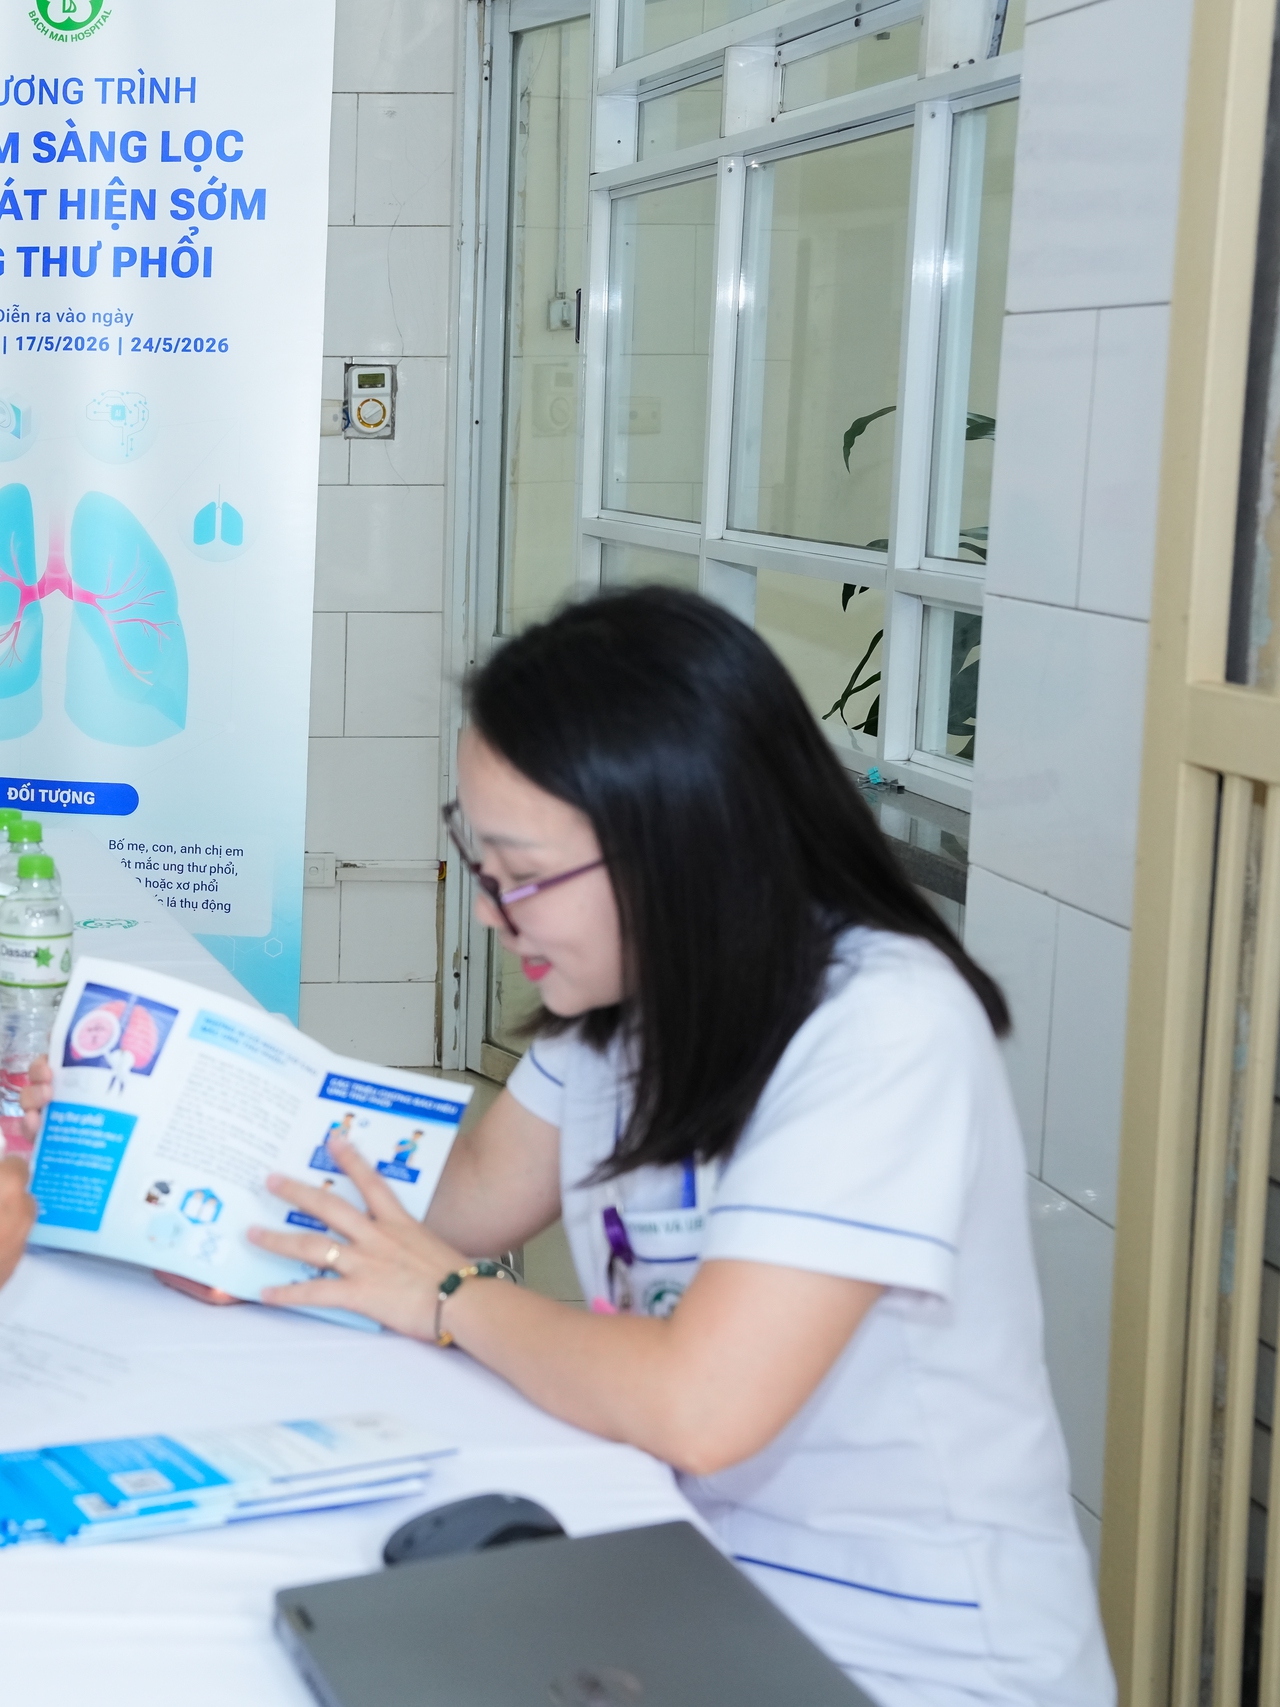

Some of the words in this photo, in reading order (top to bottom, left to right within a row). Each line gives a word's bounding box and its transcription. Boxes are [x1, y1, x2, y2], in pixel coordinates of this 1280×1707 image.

[28, 10, 50, 36] BACH
[48, 31, 68, 42] MAI
[70, 9, 112, 42] HOSPITAL
[94, 67, 197, 105] TRÌNH
[32, 117, 147, 164] SÀNG
[161, 129, 244, 172] LỌC
[59, 176, 157, 231] HIỆN
[169, 175, 267, 221] SỚM
[16, 240, 103, 278] THƯ
[112, 226, 213, 278] PHỔI
[35, 312, 51, 323] ra
[56, 307, 86, 323] vào
[91, 308, 134, 328] ngày
[15, 336, 110, 352] 17/5/2026
[130, 337, 229, 353] 24/5/2026
[7, 782, 35, 802] ĐỐI
[38, 788, 96, 808] TƯỢNG
[108, 838, 125, 851] Bố
[127, 840, 149, 854] mẹ,
[152, 843, 177, 855] con,
[180, 844, 202, 855] anh
[204, 844, 222, 859] chị
[225, 847, 244, 857] em
[134, 856, 160, 871] mắc
[162, 862, 184, 874] ung
[187, 862, 207, 874] thư
[209, 861, 238, 876] phổi,
[145, 877, 173, 892] hoặc
[176, 881, 191, 891] xơ
[193, 878, 219, 894] phổi
[166, 896, 177, 908] lá
[180, 898, 198, 912] thụ
[201, 898, 232, 914] động
[0, 943, 39, 958] Dasan
